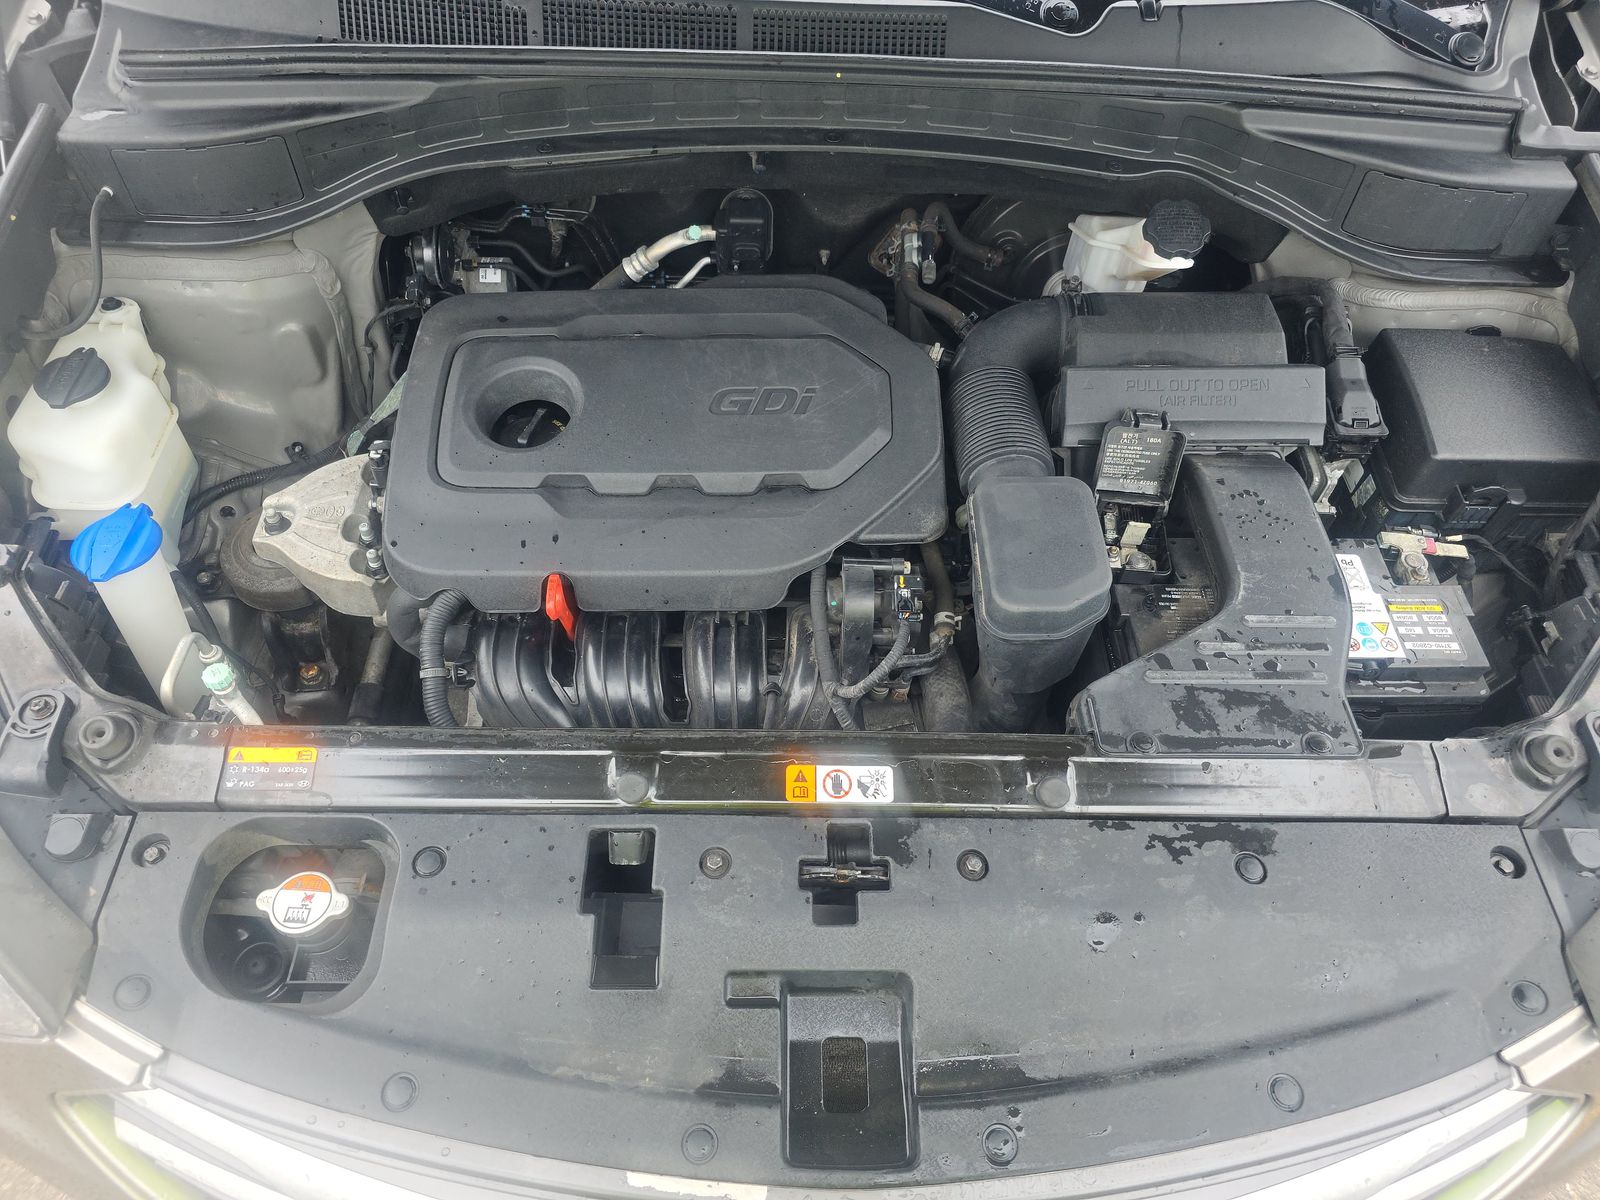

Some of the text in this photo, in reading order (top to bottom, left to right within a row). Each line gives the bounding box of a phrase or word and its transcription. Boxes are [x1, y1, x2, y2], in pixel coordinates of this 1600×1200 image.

[1125, 378, 1270, 392] PULL OUT TO OPEN
[708, 386, 820, 415] GDi
[1159, 394, 1237, 407] (AIR FILTER)
